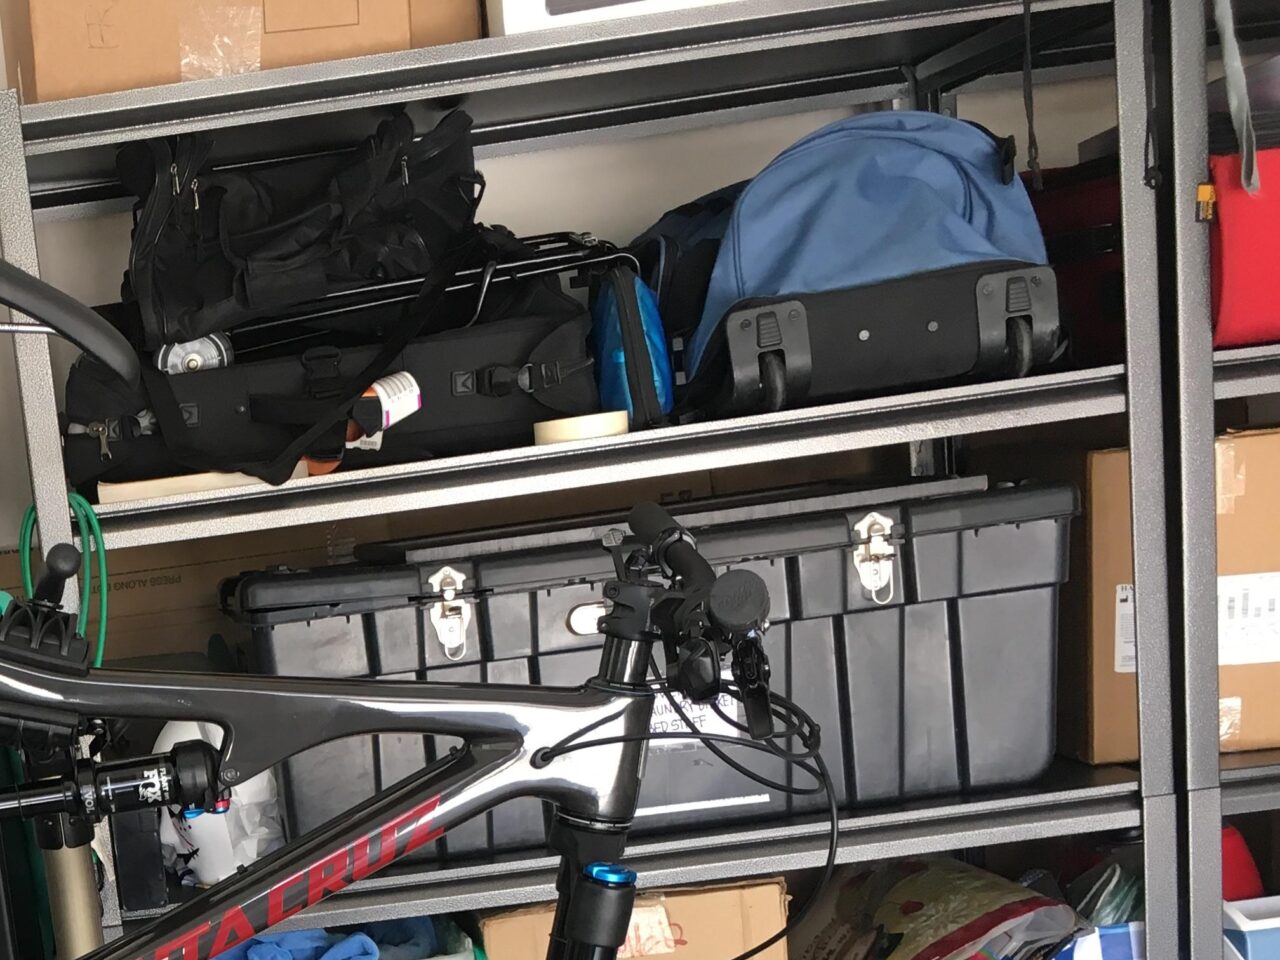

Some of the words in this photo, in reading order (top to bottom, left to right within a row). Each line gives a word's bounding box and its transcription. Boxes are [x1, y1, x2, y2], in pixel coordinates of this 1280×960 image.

[113, 578, 148, 590] ALONG
[651, 699, 694, 717] AUNRY
[671, 714, 707, 731] STFF
[267, 794, 446, 926] CRUZ
